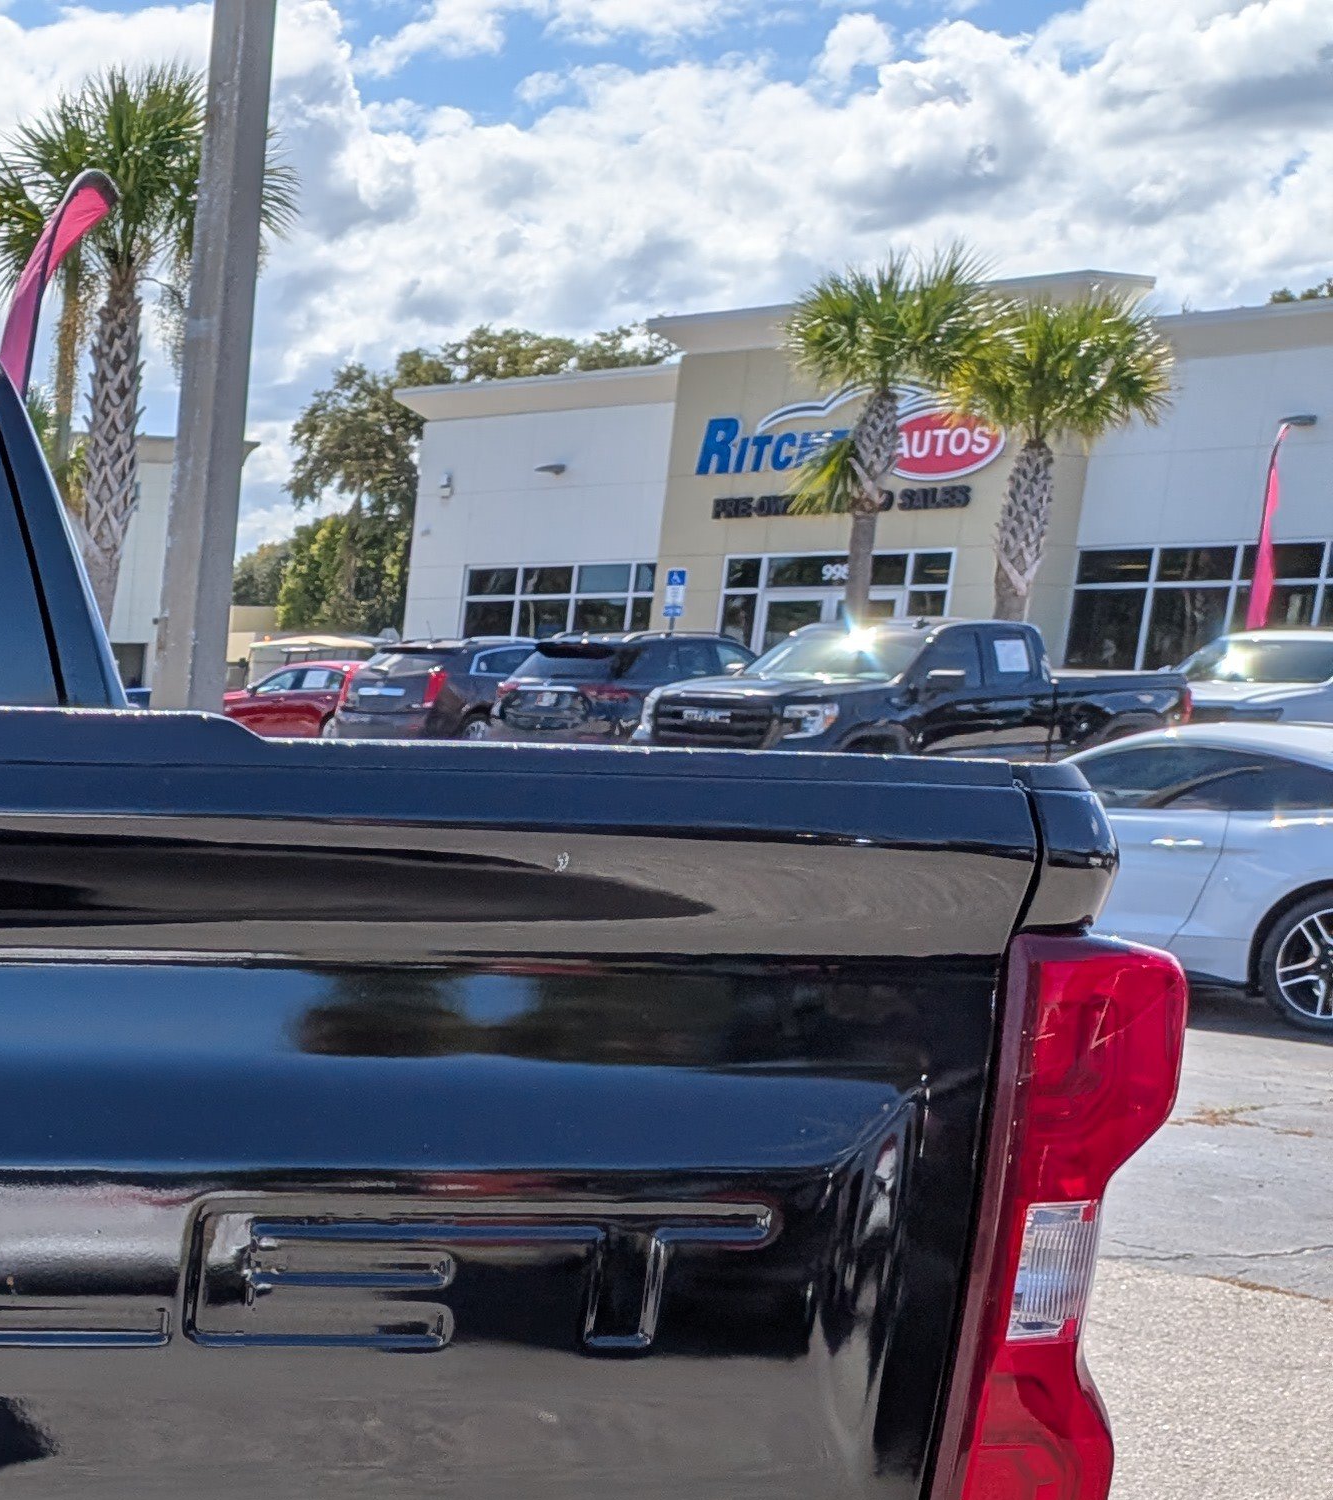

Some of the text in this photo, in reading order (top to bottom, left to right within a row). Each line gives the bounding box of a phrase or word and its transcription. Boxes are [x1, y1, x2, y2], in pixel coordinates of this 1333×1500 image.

[695, 417, 991, 475] RITC AUTOS
[711, 493, 818, 519] PRE-OW
[897, 485, 973, 511] SALES
